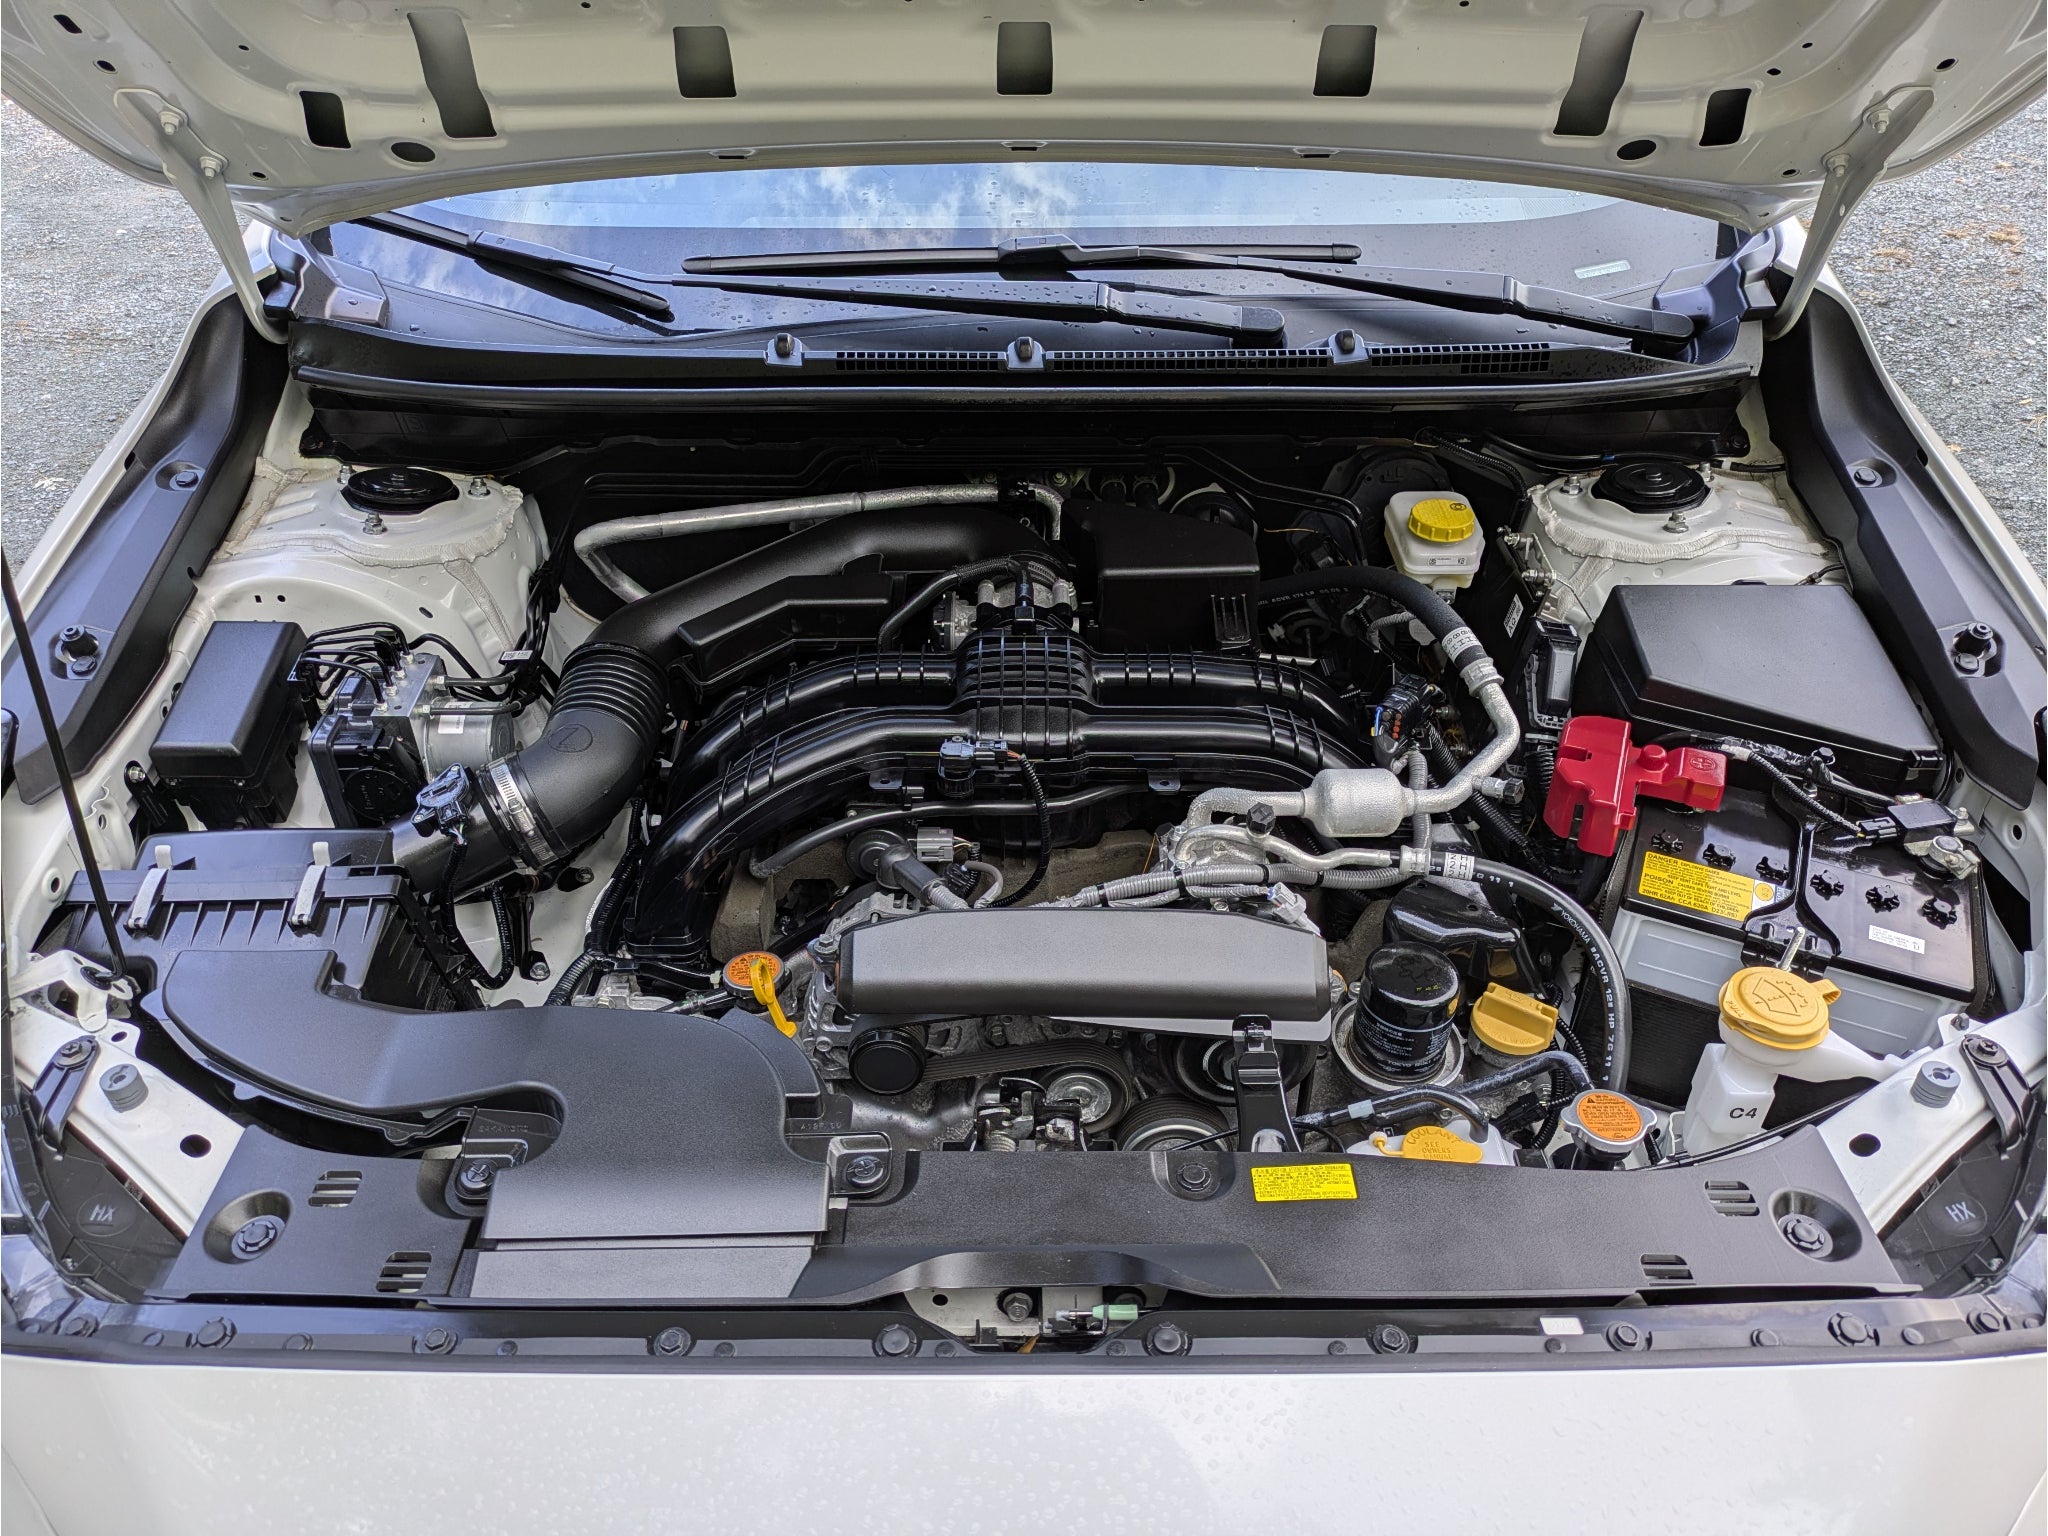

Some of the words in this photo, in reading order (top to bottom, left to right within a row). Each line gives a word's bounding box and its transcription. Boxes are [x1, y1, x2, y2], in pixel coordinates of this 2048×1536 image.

[1648, 853, 1678, 864] DANGER
[1644, 873, 1673, 884] POISON
[1560, 911, 1590, 944] YOKOHAMA
[1608, 1012, 1615, 1028] HP
[1730, 1108, 1758, 1118] C4
[1406, 1127, 1463, 1145] COOLANT
[89, 1204, 115, 1221] HX
[1944, 1201, 1976, 1222] HX
